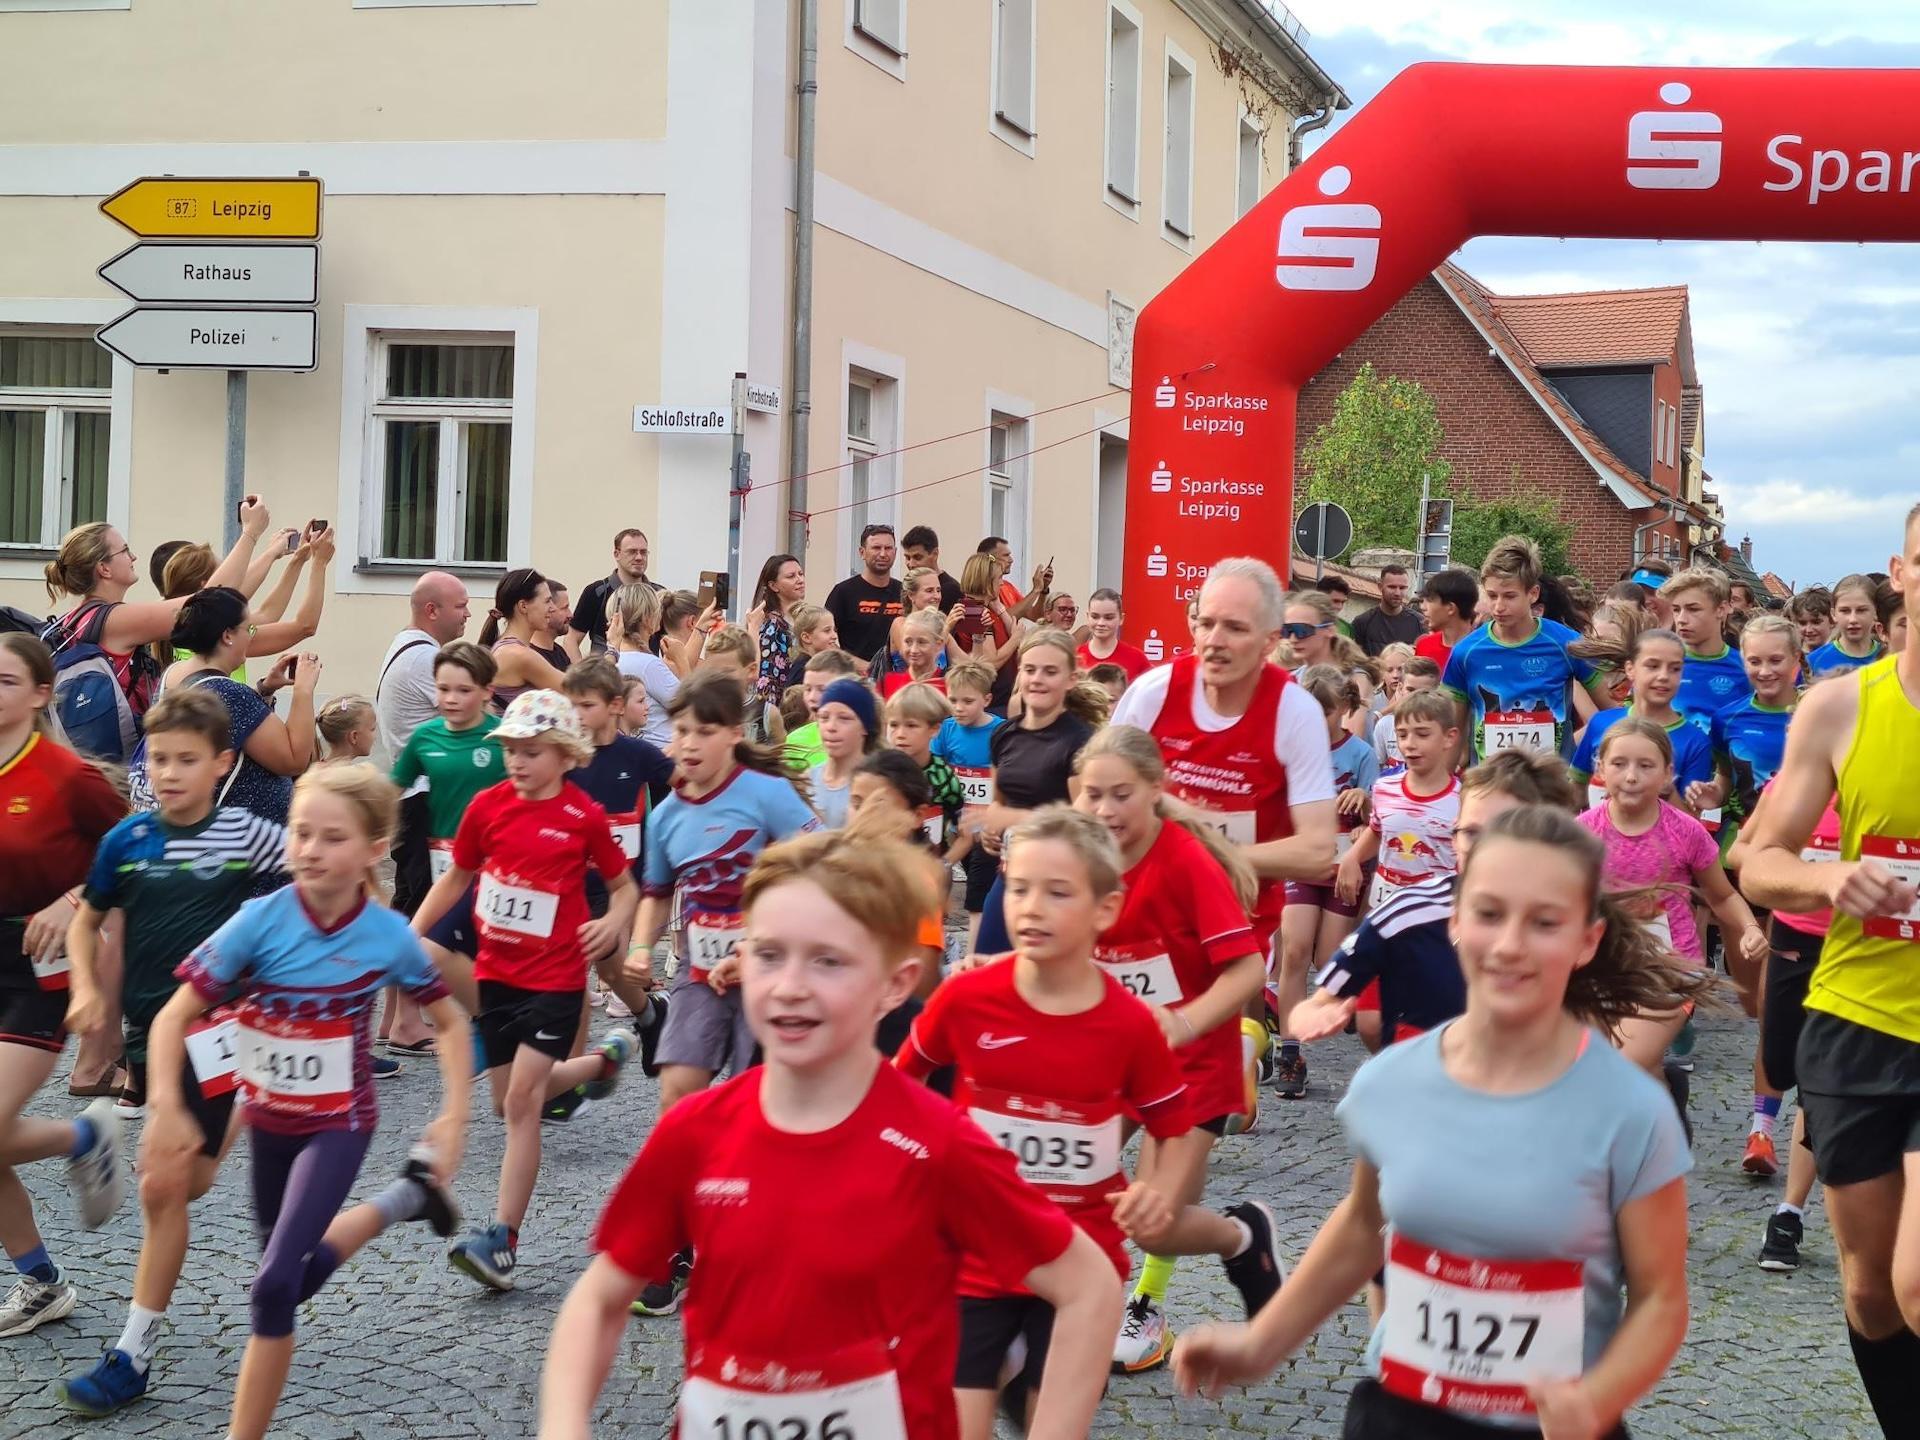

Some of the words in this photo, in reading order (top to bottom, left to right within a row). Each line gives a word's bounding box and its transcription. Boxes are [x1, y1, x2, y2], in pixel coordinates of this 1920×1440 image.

[1763, 134, 1920, 205] Spar
[174, 202, 190, 215] 87
[212, 200, 272, 220] Leipzig
[183, 264, 251, 281] Rathaus
[190, 328, 246, 345] Polizei
[1184, 391, 1268, 411] Sparkasse
[641, 410, 725, 427] Schloßstraße
[1182, 415, 1245, 436] Leipzig
[1180, 477, 1265, 497] Sparkasse
[1179, 500, 1241, 521] Leipzig
[1176, 562, 1212, 582] Spa
[1496, 731, 1541, 748] 2174
[998, 1131, 1095, 1170] 1035
[1417, 1299, 1542, 1361] 1127
